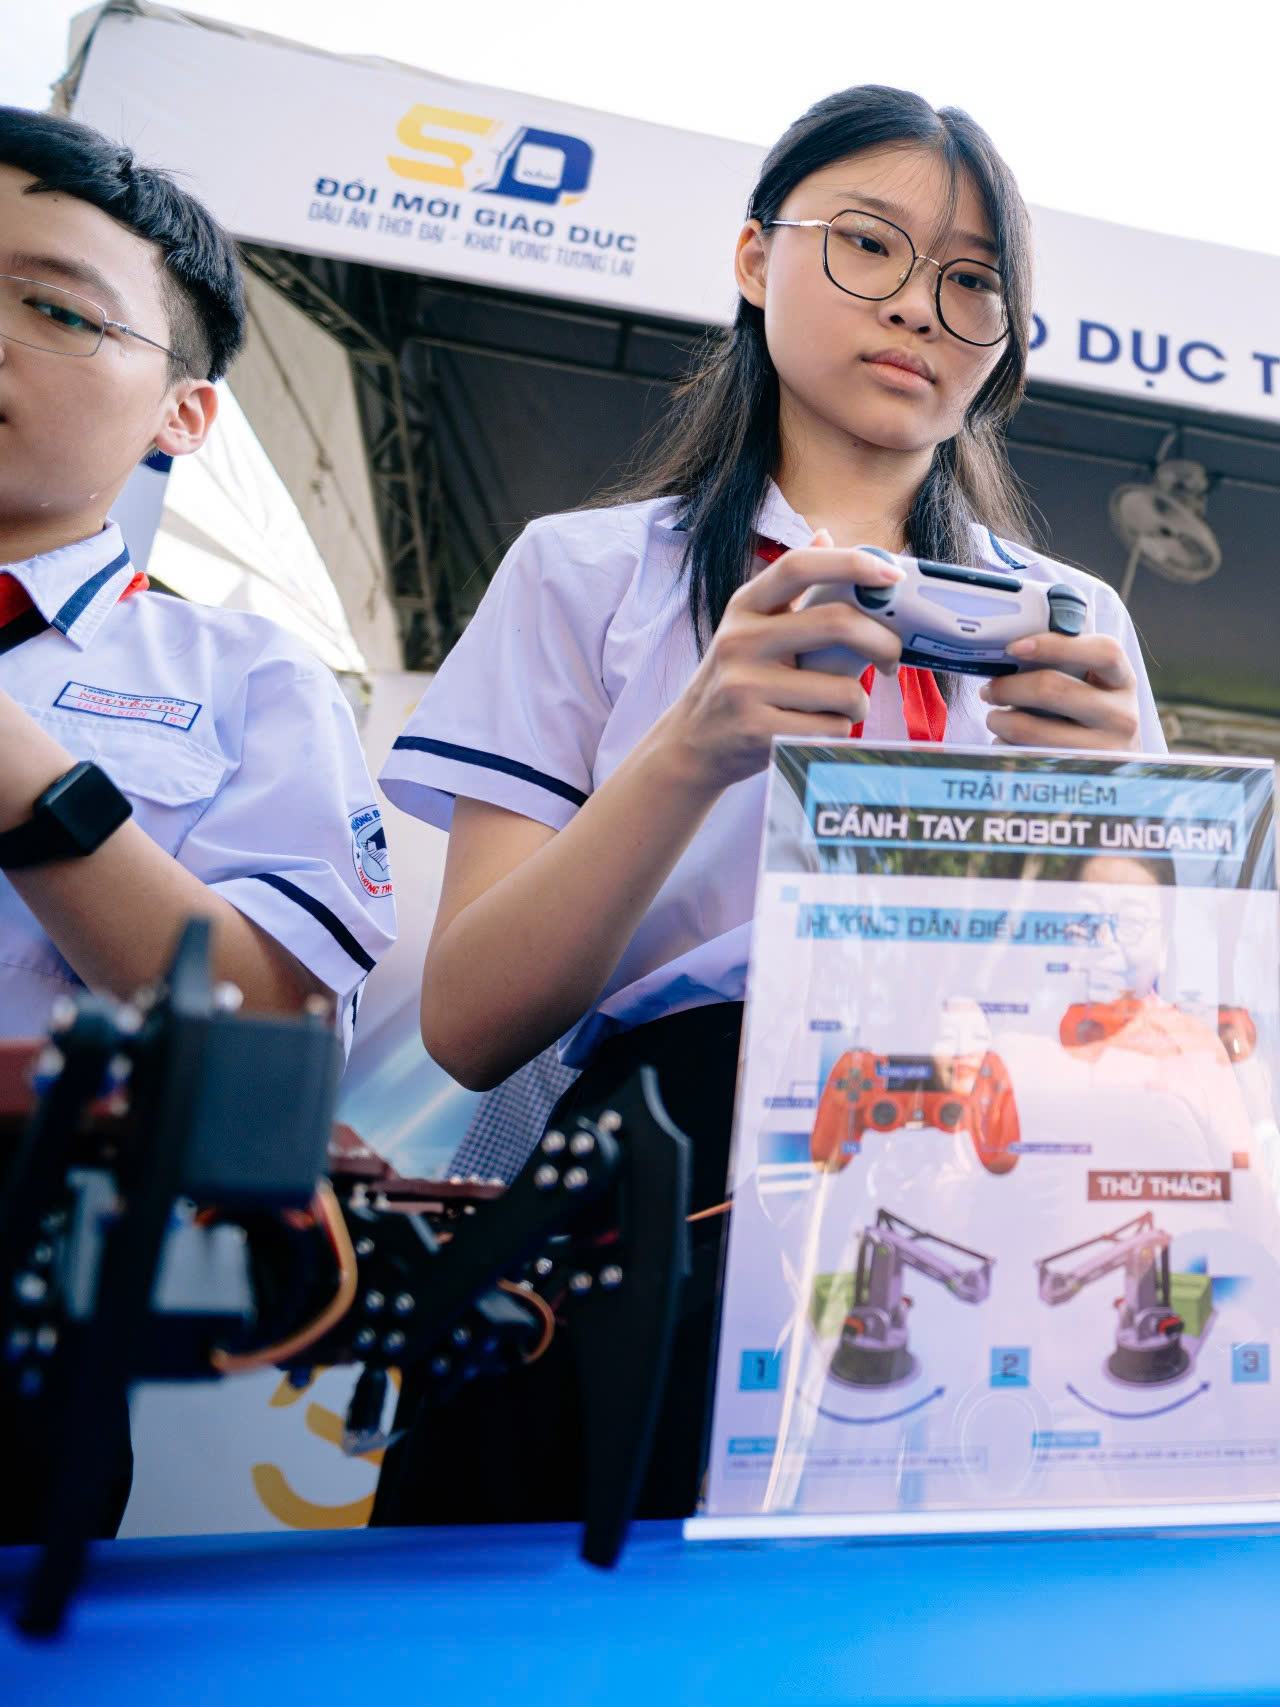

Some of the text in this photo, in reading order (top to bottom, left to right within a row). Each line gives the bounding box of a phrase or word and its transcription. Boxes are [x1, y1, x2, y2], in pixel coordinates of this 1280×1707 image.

[1078, 319, 1227, 388] DỤC
[817, 806, 1233, 852] CÁNH TAY ROBOT UNOARM
[754, 1356, 768, 1381] 1
[1000, 1353, 1020, 1378] 2
[1240, 1349, 1261, 1375] 3
